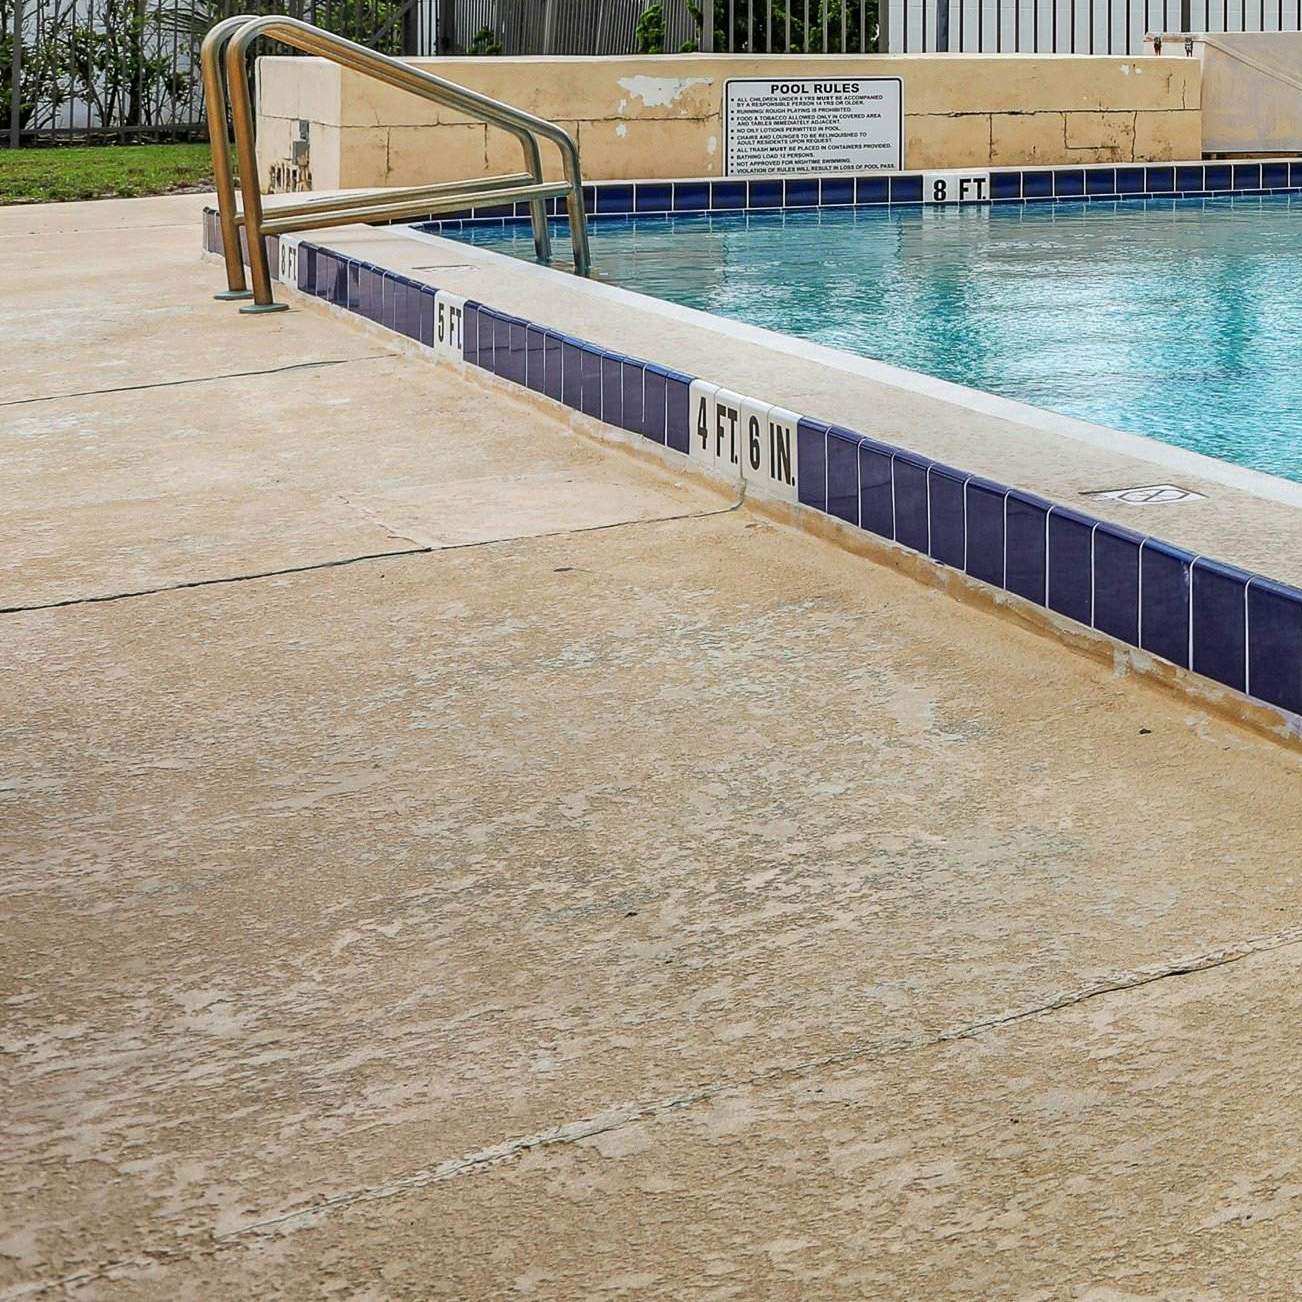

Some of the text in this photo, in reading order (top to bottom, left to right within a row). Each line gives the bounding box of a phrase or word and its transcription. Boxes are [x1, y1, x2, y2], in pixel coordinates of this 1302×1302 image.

[771, 83, 860, 94] POOL RULES
[934, 178, 986, 201] 8 FT.
[282, 244, 286, 274] 8
[438, 302, 444, 343] 5
[697, 396, 796, 486] 4 FT. 6 IN.
